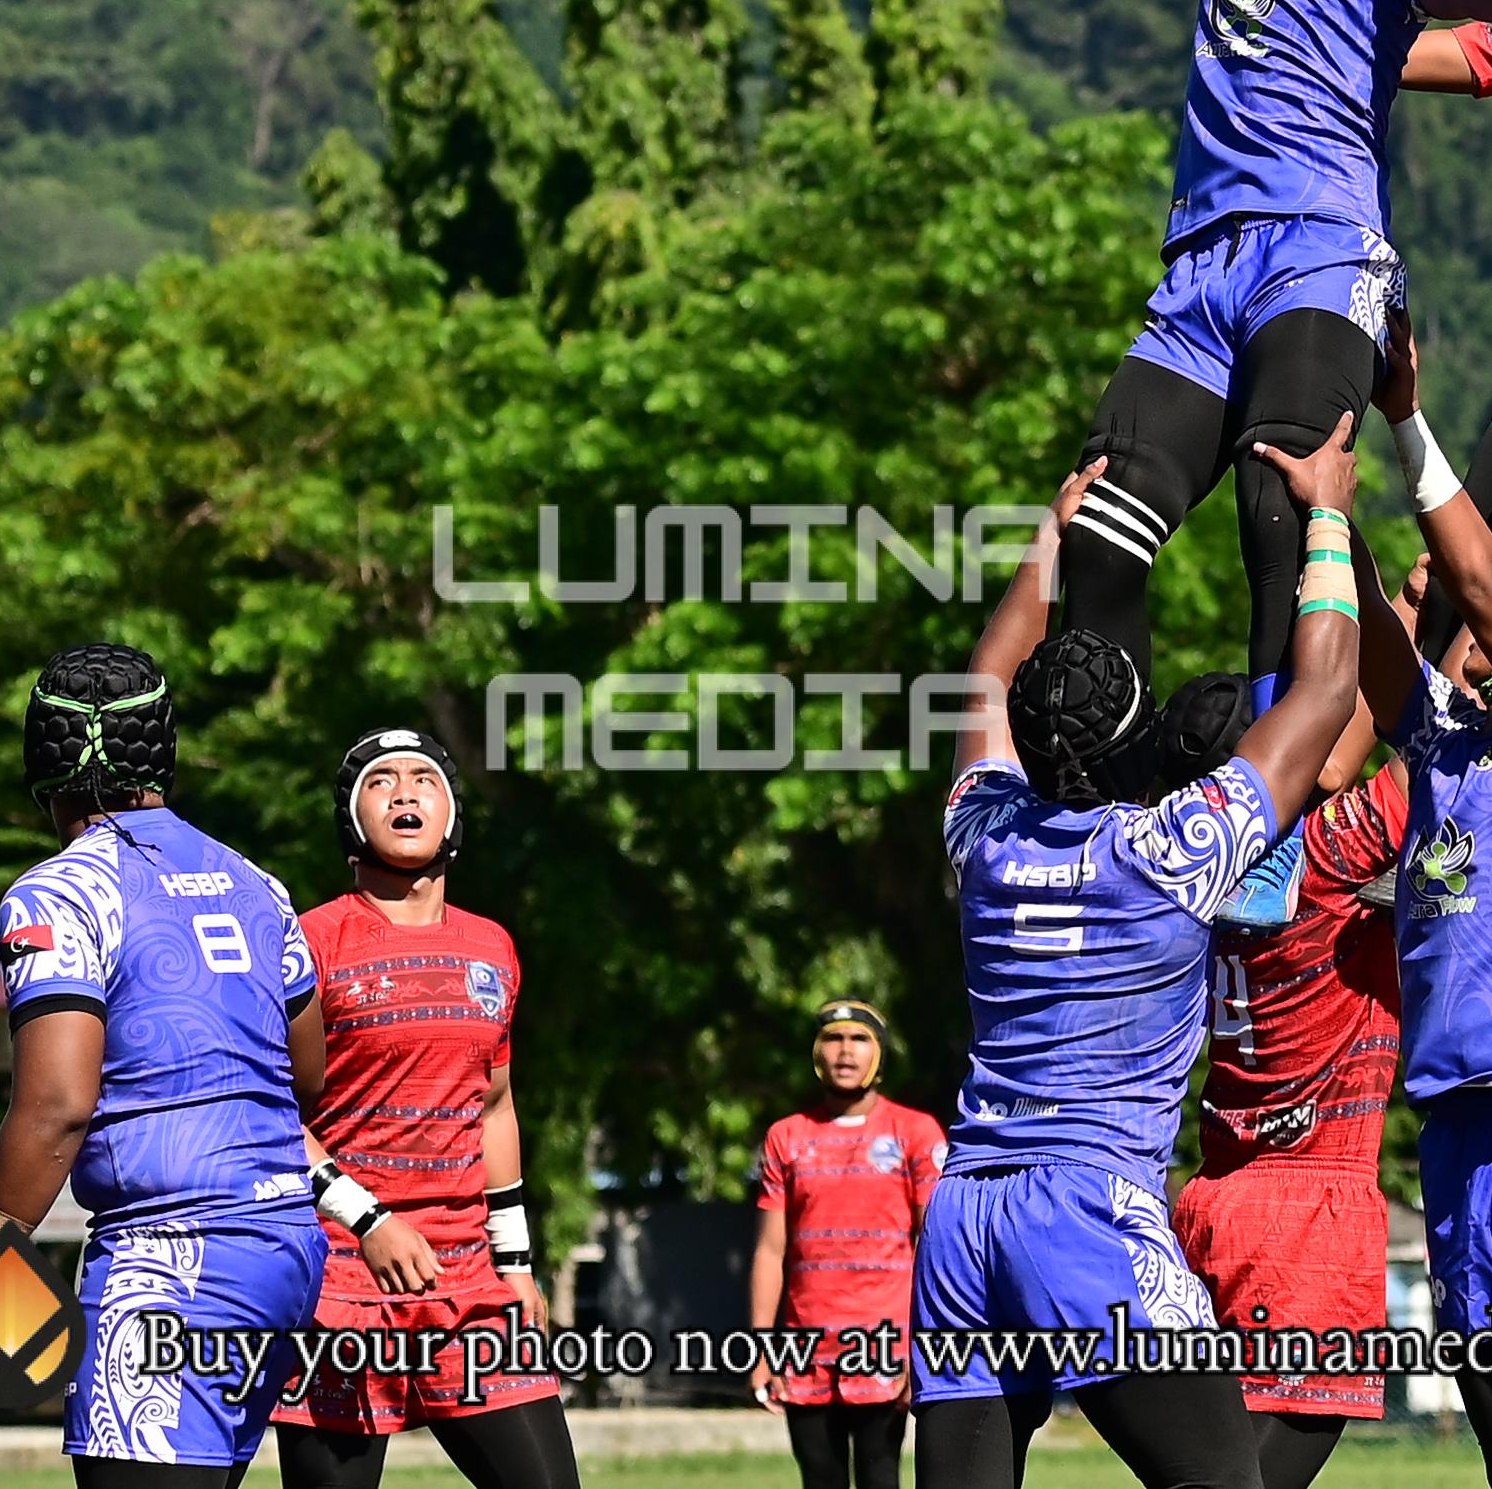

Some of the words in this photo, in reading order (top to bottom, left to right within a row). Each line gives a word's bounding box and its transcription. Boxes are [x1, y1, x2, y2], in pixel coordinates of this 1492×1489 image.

[158, 872, 235, 898] HSBP
[1002, 861, 1097, 888] HSBP
[192, 913, 252, 974] 8
[1008, 902, 1086, 957] 5
[1212, 955, 1256, 1065] 4
